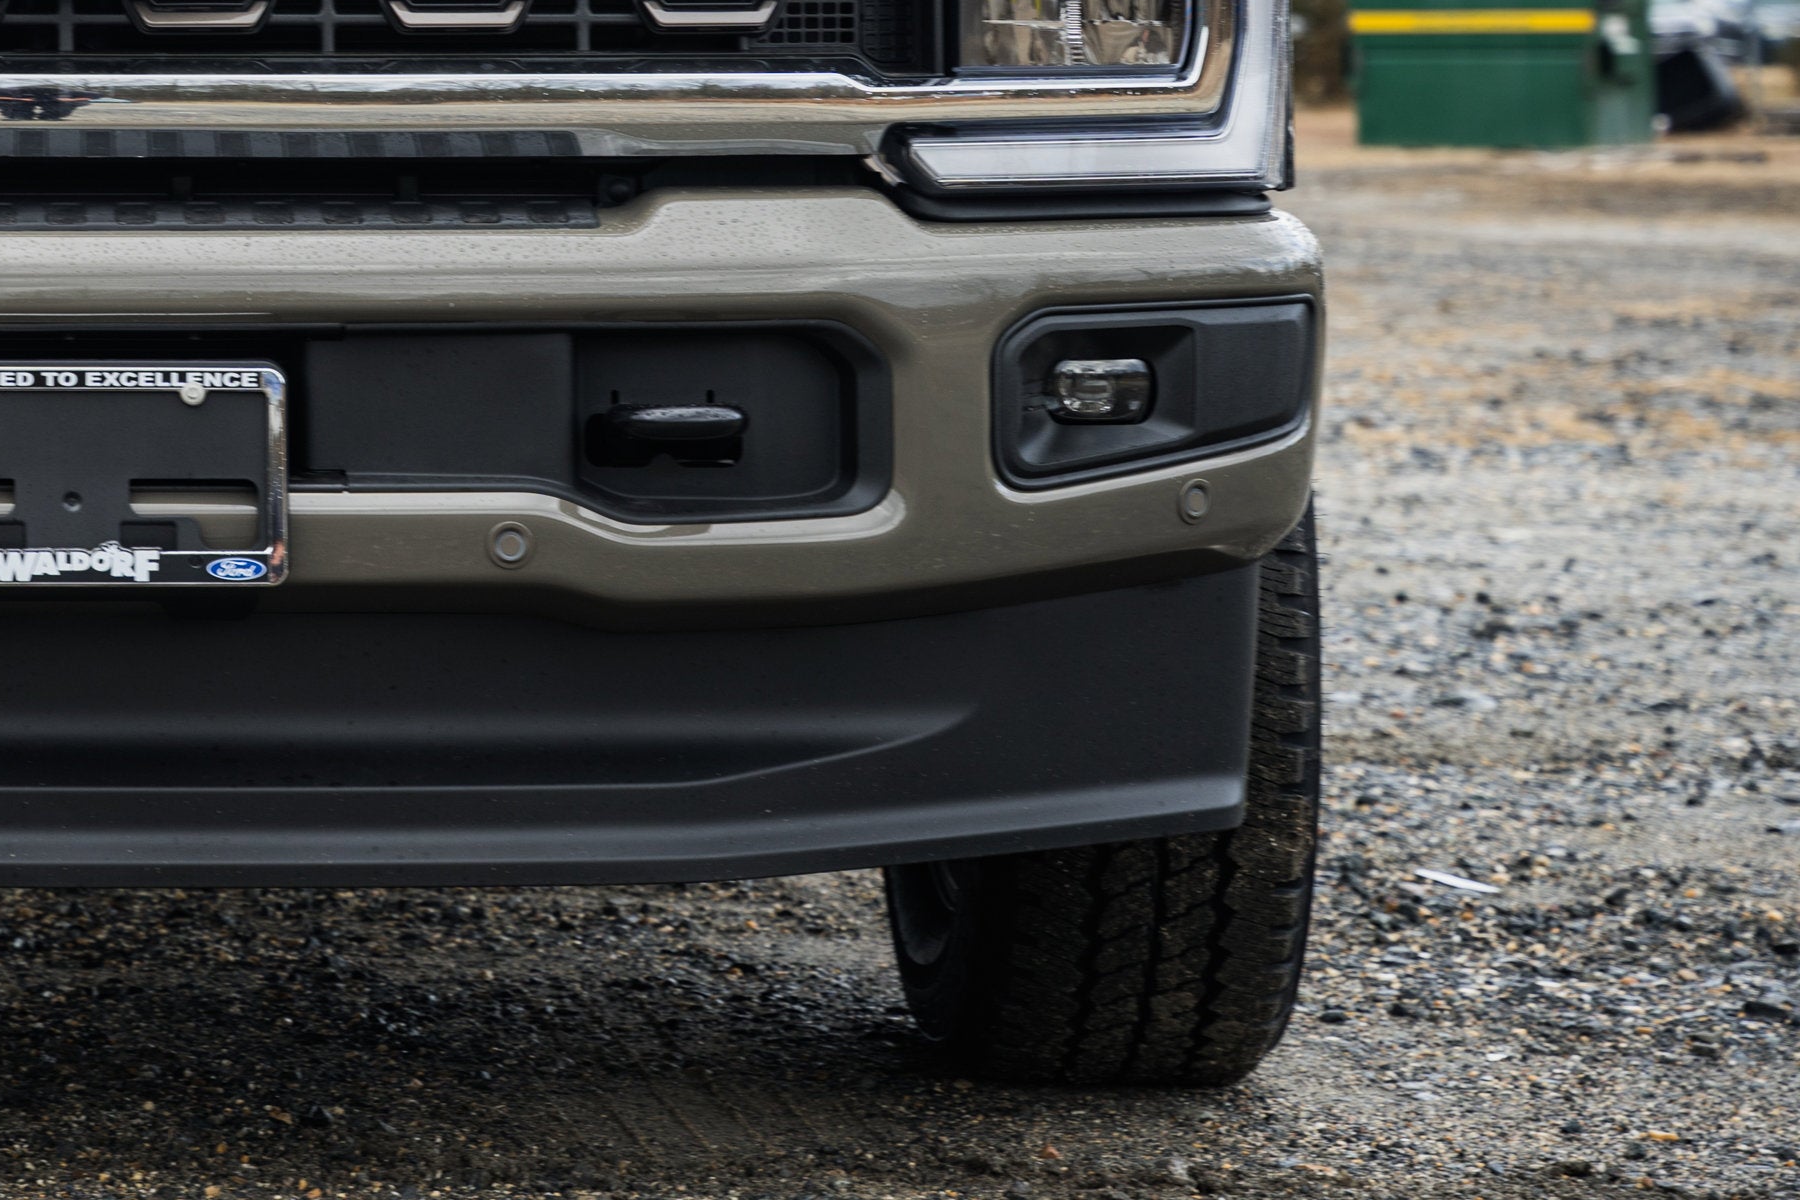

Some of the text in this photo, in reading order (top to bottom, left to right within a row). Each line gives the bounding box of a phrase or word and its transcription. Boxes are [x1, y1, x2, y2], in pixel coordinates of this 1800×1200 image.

[40, 371, 78, 388] TO
[84, 372, 258, 388] EXCELLENCE
[216, 559, 257, 578] Ford
